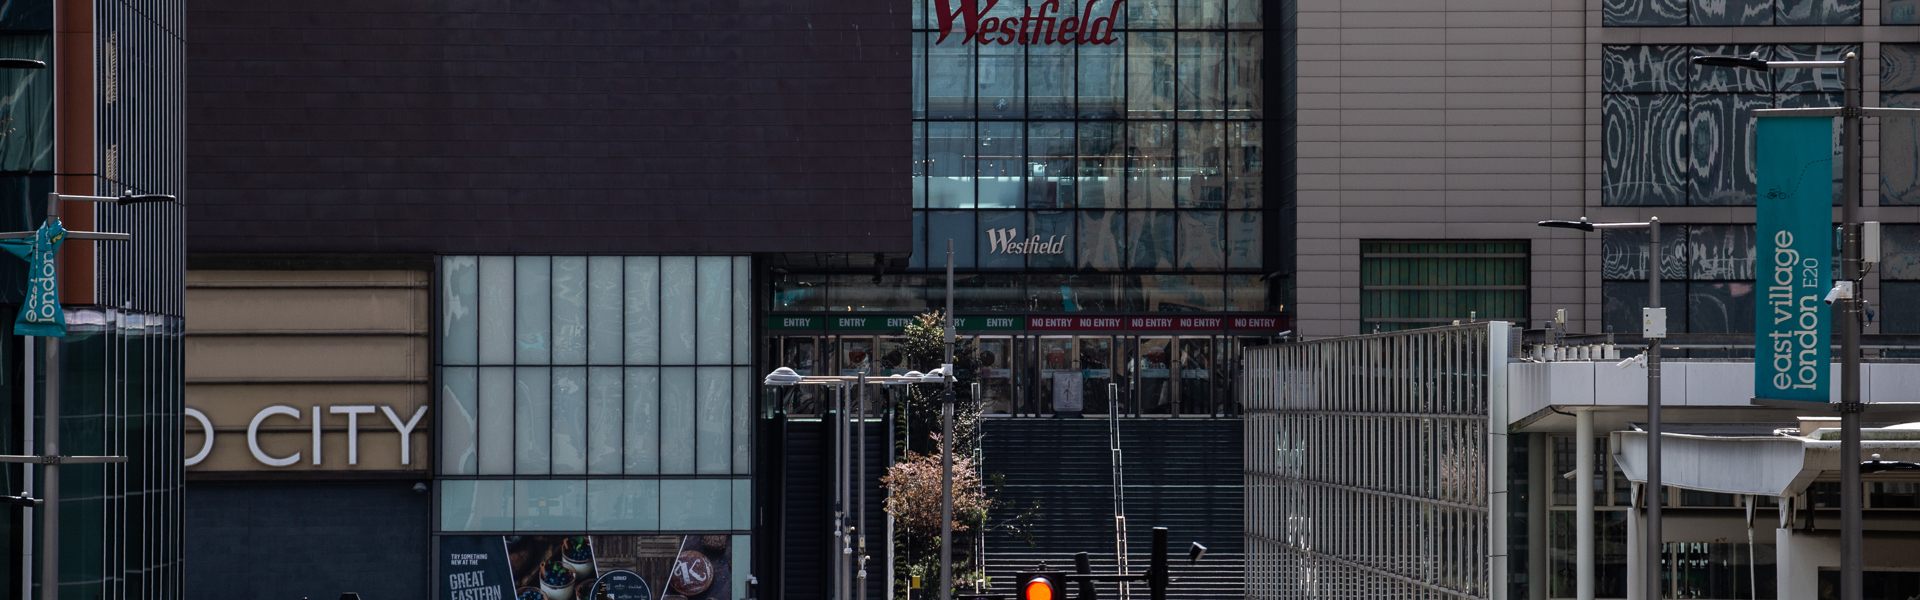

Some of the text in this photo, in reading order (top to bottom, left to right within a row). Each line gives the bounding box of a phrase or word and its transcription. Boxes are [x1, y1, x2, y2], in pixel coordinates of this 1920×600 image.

[933, 0, 1127, 46] Westfield
[985, 227, 1067, 254] Westfield
[38, 250, 55, 323] london
[1769, 230, 1800, 390] east village
[783, 317, 811, 327] ENTRY
[839, 317, 866, 327] ENTRY
[887, 317, 915, 327] ENTRY
[986, 317, 1014, 327] ENTRY
[1032, 318, 1073, 328] NO ENTRY
[1080, 318, 1121, 328] NO ENTRY
[1132, 318, 1173, 328] NO ENTRY
[1180, 318, 1221, 328] NO ENTRY
[1234, 318, 1276, 328] NO ENTRY
[1793, 257, 1819, 391] london E20
[246, 404, 428, 467] CITY
[449, 570, 485, 590] GREAT
